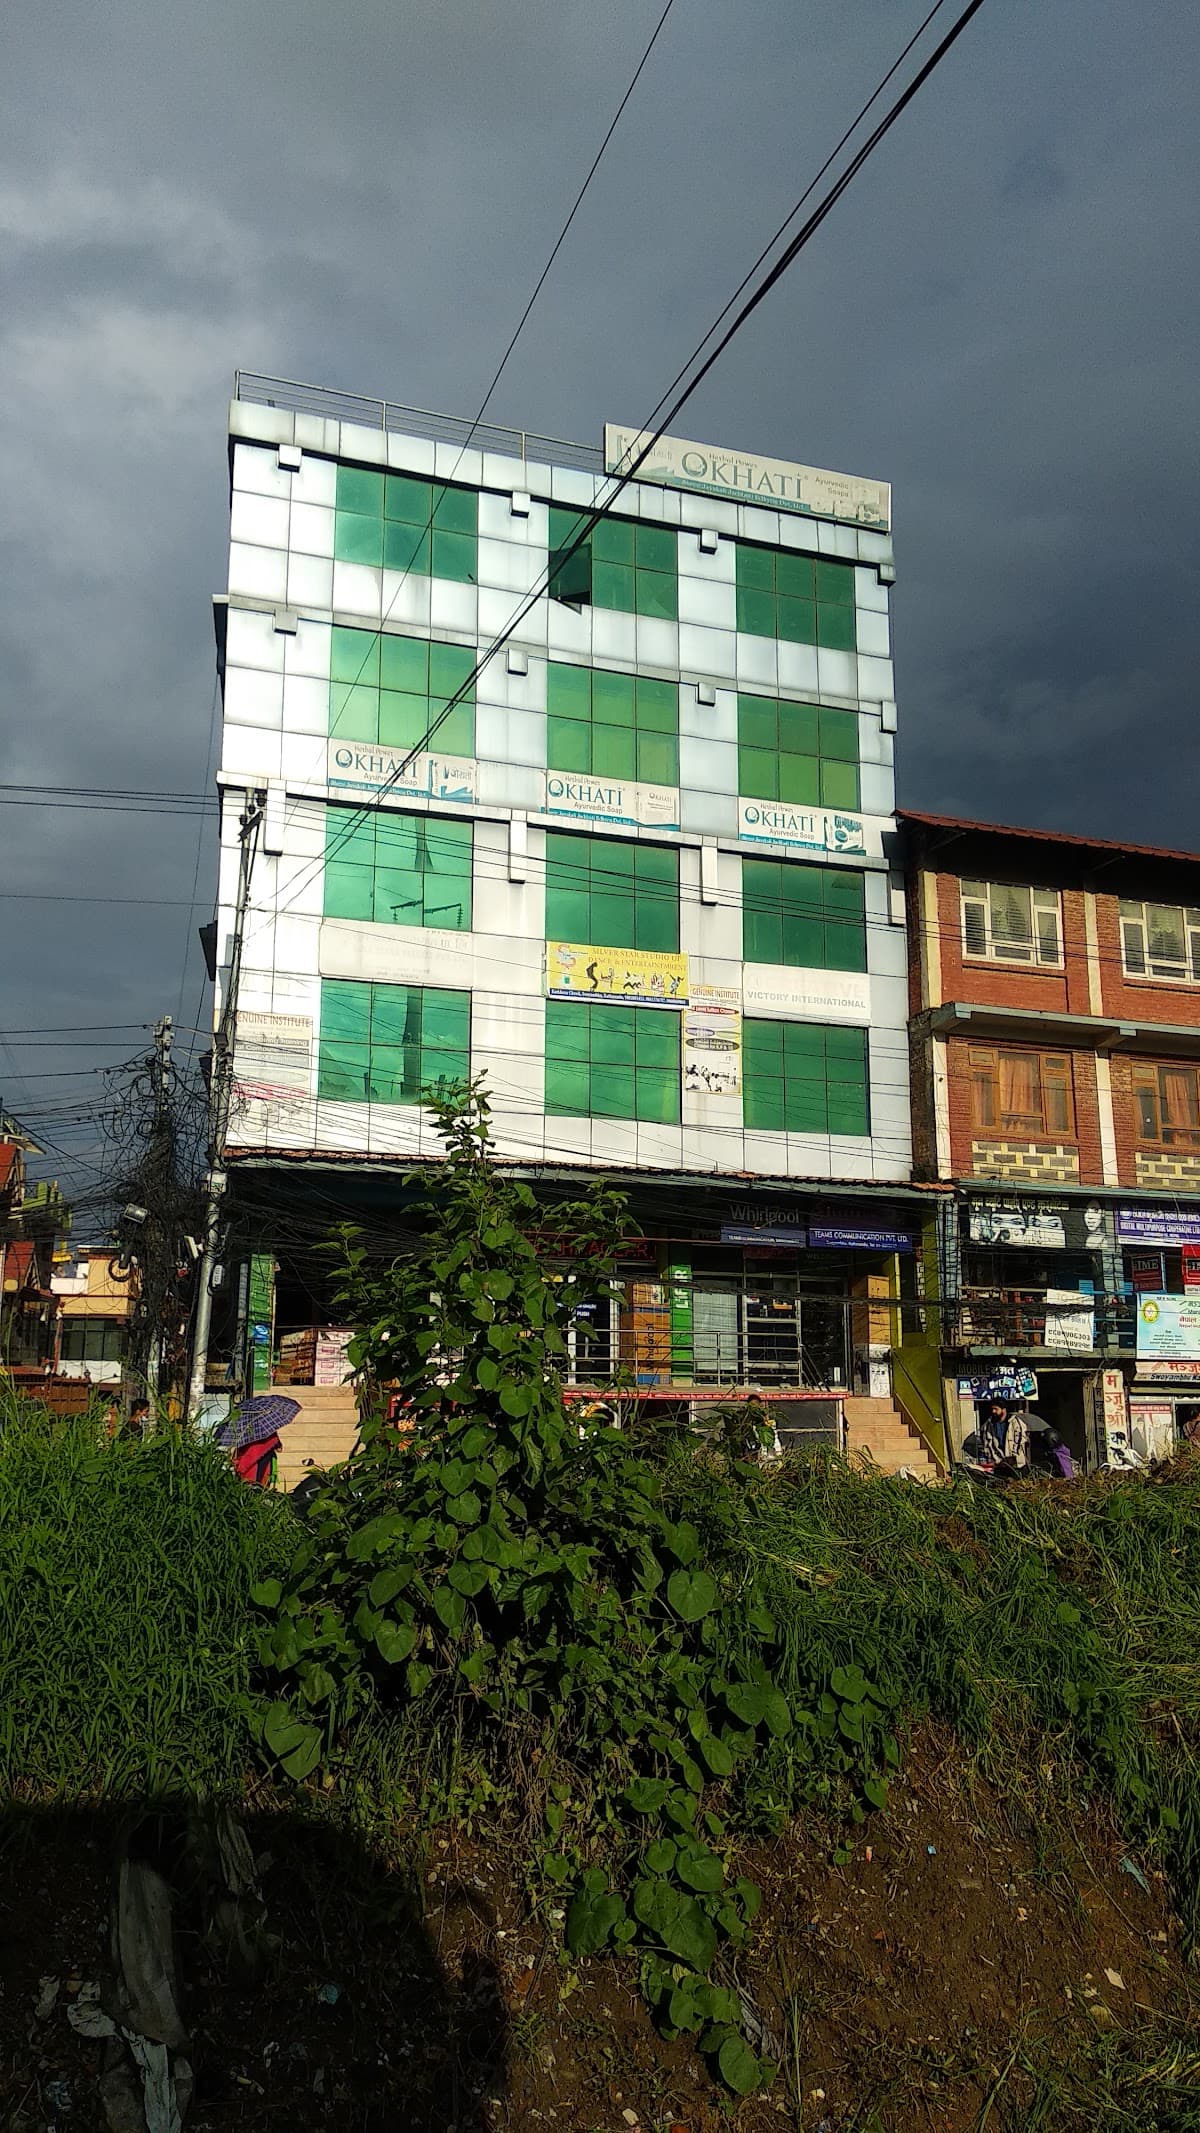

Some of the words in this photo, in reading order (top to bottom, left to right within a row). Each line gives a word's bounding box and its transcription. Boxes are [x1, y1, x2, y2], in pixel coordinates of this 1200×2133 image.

[681, 451, 802, 499] OKHATI
[548, 778, 623, 806] OKHATI
[574, 801, 606, 814] Ayurvedic
[606, 805, 623, 816] Soap
[744, 806, 814, 833] OKHATI
[768, 827, 799, 840] Ayurvedic
[799, 831, 815, 841] Soap
[591, 948, 619, 957] SILVER
[619, 950, 639, 959] STAR
[639, 951, 670, 962] STUDIO
[715, 989, 740, 1000] INSTITUTE
[747, 991, 790, 1002] VICTORY
[791, 995, 867, 1009] INTERNATIONAL
[235, 1011, 268, 1025] ENUINE
[269, 1014, 311, 1028] INSTITUTE
[729, 1203, 800, 1227] Whirlpool
[814, 1230, 833, 1239] TEAMS
[833, 1231, 884, 1242] COMMUNICATION
